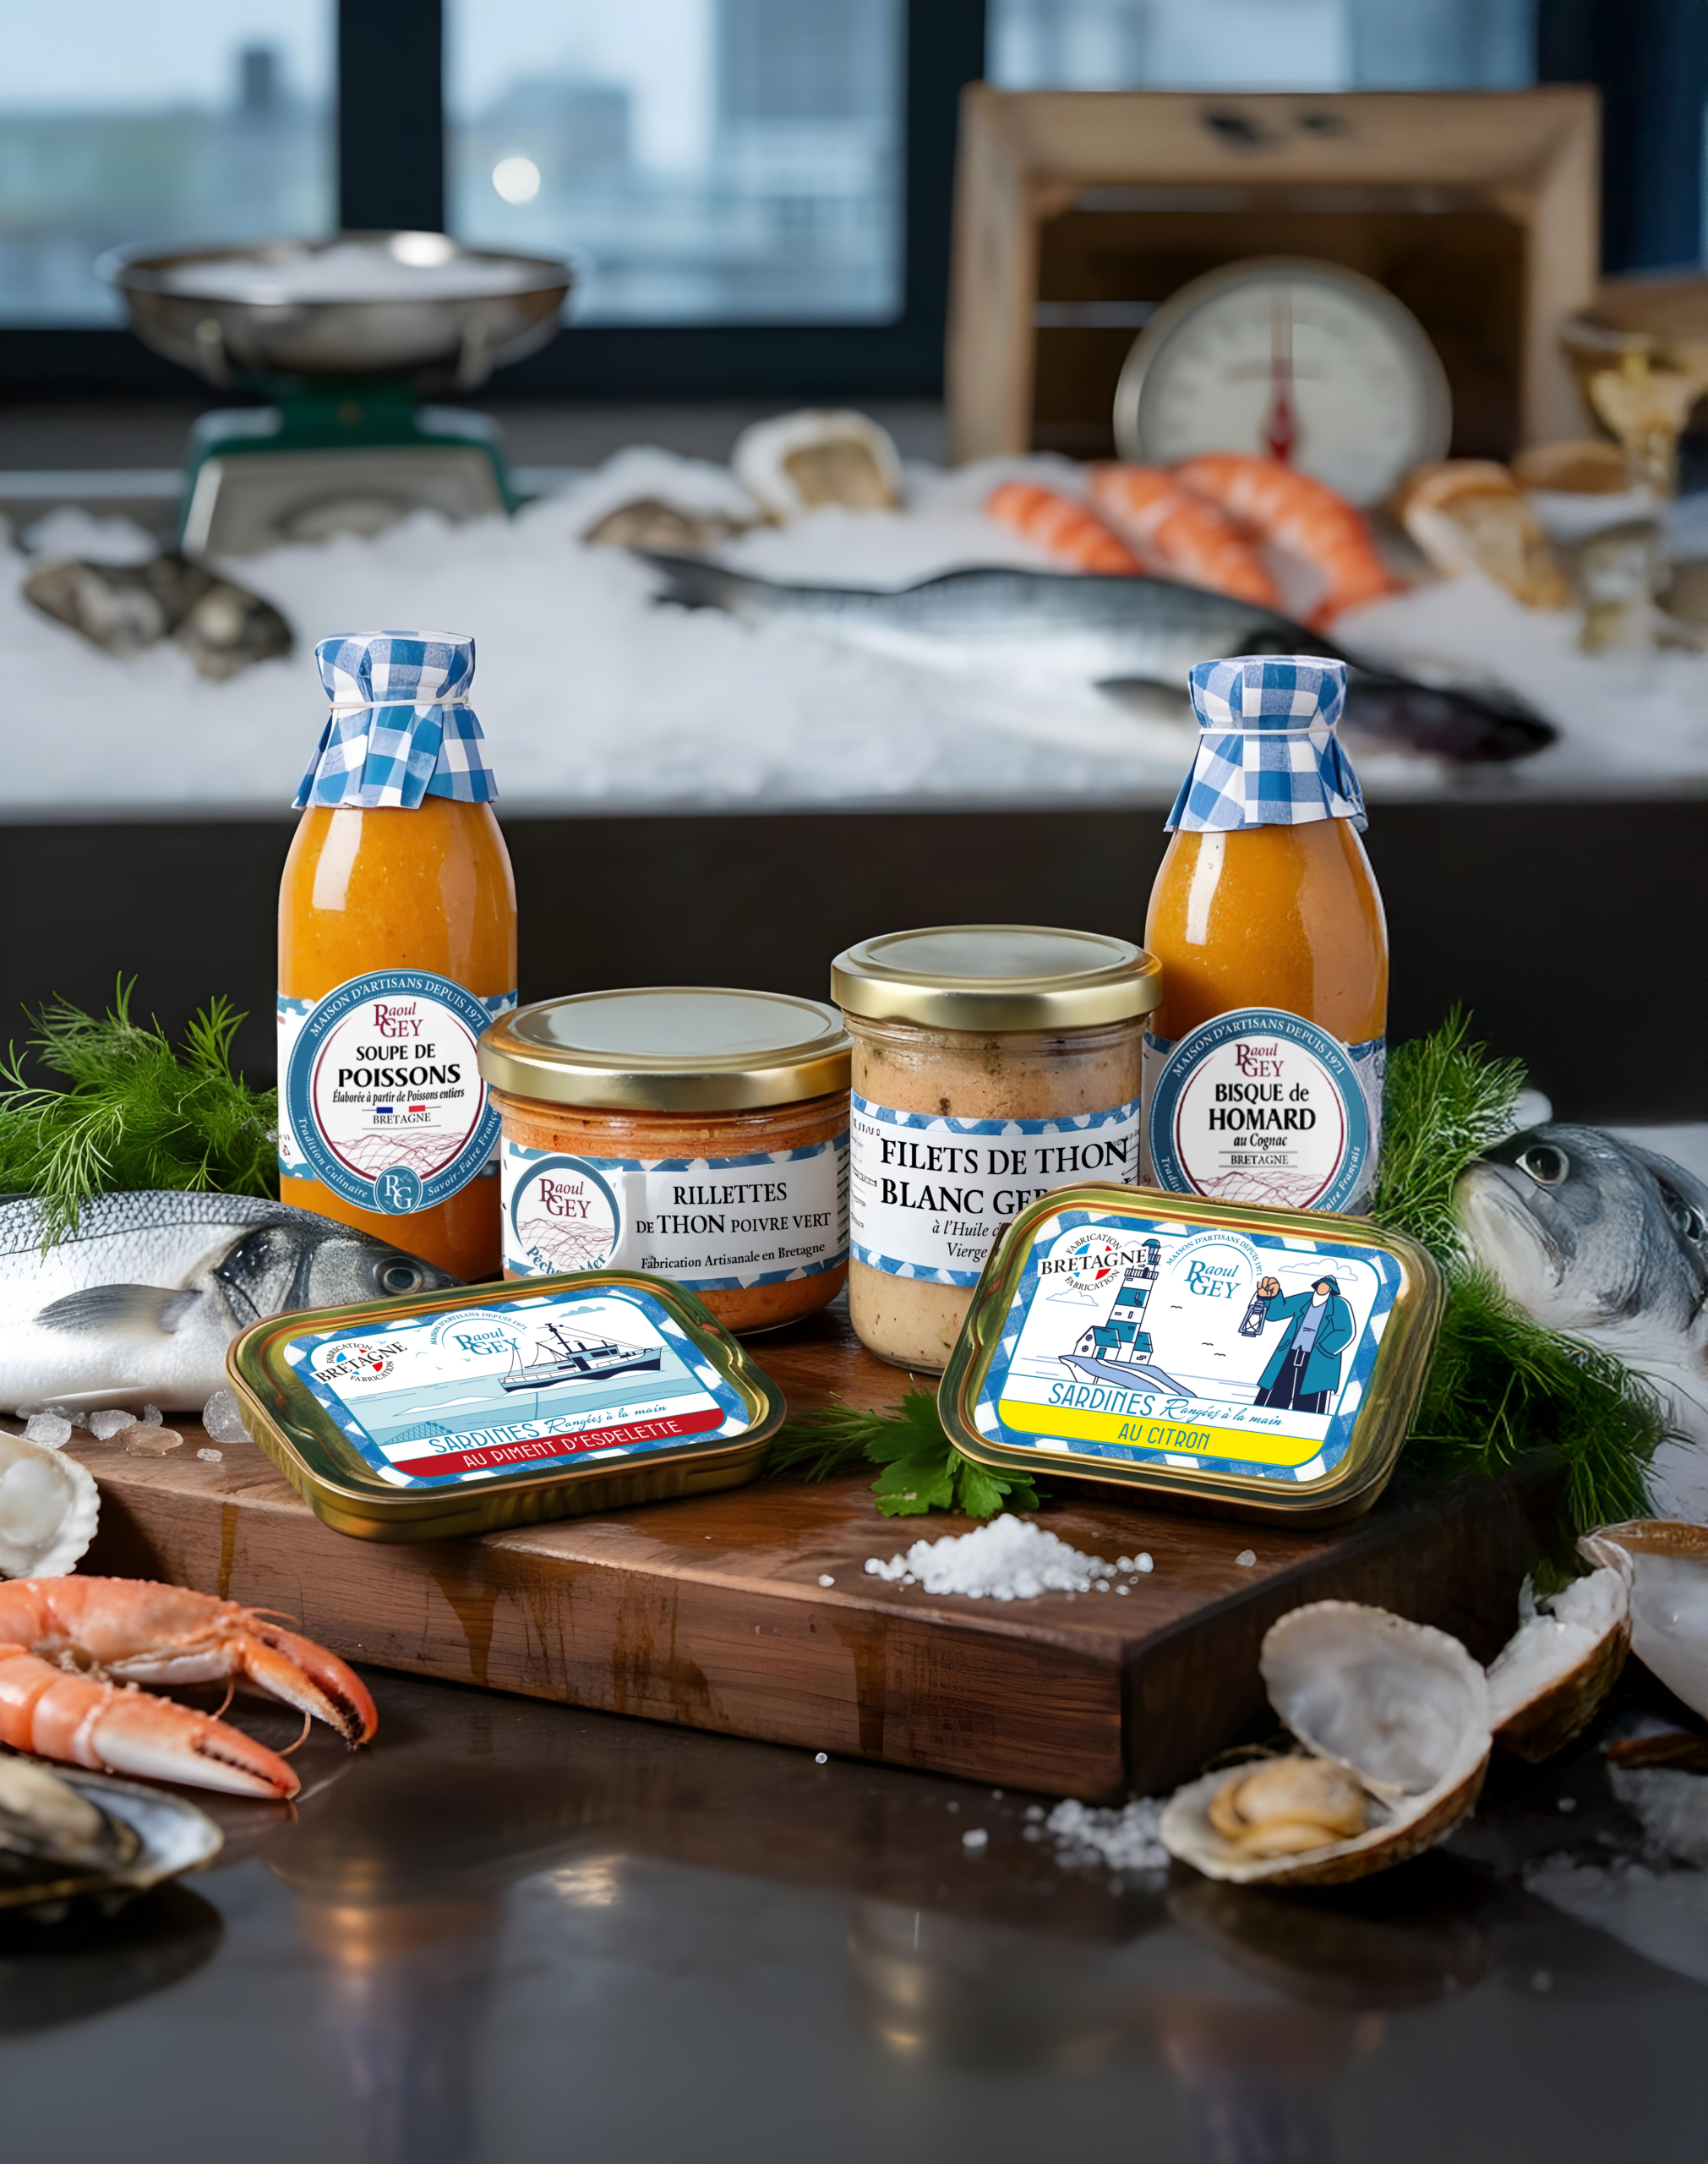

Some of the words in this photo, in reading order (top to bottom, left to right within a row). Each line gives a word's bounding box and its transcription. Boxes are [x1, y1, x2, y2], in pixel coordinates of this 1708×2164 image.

[309, 993, 349, 1037] MAISON
[424, 981, 467, 1008] DEPUIS
[464, 1005, 485, 1029] 1971
[373, 1002, 417, 1026] Raoul
[379, 1018, 423, 1038] GEY
[356, 1045, 409, 1061] SOUPE
[414, 1043, 436, 1059] DE
[1172, 1035, 1213, 1077] MAISON
[1286, 1021, 1329, 1053] DEPUIS
[1324, 1051, 1345, 1074] 1971
[1235, 1043, 1278, 1066] Raoul
[338, 1063, 461, 1088] POISSONS
[1241, 1057, 1285, 1077] GEY
[332, 1089, 365, 1103] Élaborée
[366, 1091, 372, 1102] à
[372, 1091, 396, 1106] partir
[396, 1090, 406, 1102] de
[407, 1090, 439, 1101] Poissons
[439, 1087, 465, 1099] entiers
[1215, 1083, 1284, 1105] BISQUE
[1289, 1083, 1309, 1101] de
[373, 1112, 431, 1124] BRETAGNE
[1209, 1107, 1316, 1131] HOMARD
[1233, 1136, 1247, 1146] au
[1250, 1133, 1287, 1150] Cognac
[297, 1117, 325, 1167] Tradition
[325, 1165, 368, 1199] Culinaire
[881, 1138, 979, 1174] FILETS
[987, 1150, 1027, 1175] DE
[1035, 1138, 1129, 1174] THON
[1231, 1155, 1289, 1165] BRETAGNE
[1339, 1146, 1361, 1191] Français
[428, 1148, 481, 1196] Savoir-Faire
[538, 1178, 584, 1204] Raoul
[673, 1183, 788, 1205] RILLETTES
[881, 1178, 985, 1215] BLANC
[546, 1194, 592, 1219] GEY
[636, 1221, 654, 1233] DE
[657, 1215, 725, 1234] THON
[730, 1216, 789, 1232] POIVRE
[792, 1212, 832, 1228] VERT
[932, 1219, 941, 1234] à
[947, 1243, 987, 1263] Vierge
[1066, 1233, 1121, 1254] FABRICATION
[1166, 1241, 1194, 1265] MAISON
[1239, 1240, 1259, 1261] DEPUIS
[641, 1257, 701, 1269] Fabrication
[704, 1251, 760, 1266] Artisanale
[762, 1252, 775, 1260] en
[778, 1243, 826, 1260] Bretagne
[1040, 1249, 1148, 1276] BRETAGNE
[1064, 1269, 1121, 1292] FABRICATION
[1183, 1260, 1240, 1284] Raoul
[1190, 1276, 1241, 1299] GEY
[430, 1323, 442, 1346] MAISON
[482, 1312, 513, 1323] DEPUIS
[512, 1320, 527, 1330] 1971
[451, 1327, 505, 1351] Raoul
[325, 1342, 374, 1363] FABRICATION
[470, 1337, 521, 1355] GEY
[314, 1342, 407, 1382] BRETAGNE
[350, 1360, 395, 1382] FABRICATION
[1048, 1382, 1155, 1417] SARDINES
[1160, 1398, 1220, 1424] Rangées
[1221, 1407, 1231, 1419] à
[1233, 1407, 1247, 1421] la
[1248, 1414, 1284, 1427] main
[428, 1423, 540, 1453] SARDINES
[543, 1413, 602, 1433] Rangées
[606, 1408, 614, 1420] à
[618, 1407, 631, 1418] la
[634, 1403, 668, 1416] main
[1117, 1423, 1143, 1441] AU
[1148, 1427, 1211, 1451] CITRON
[462, 1453, 488, 1467] AU
[490, 1440, 558, 1463] PIMENT
